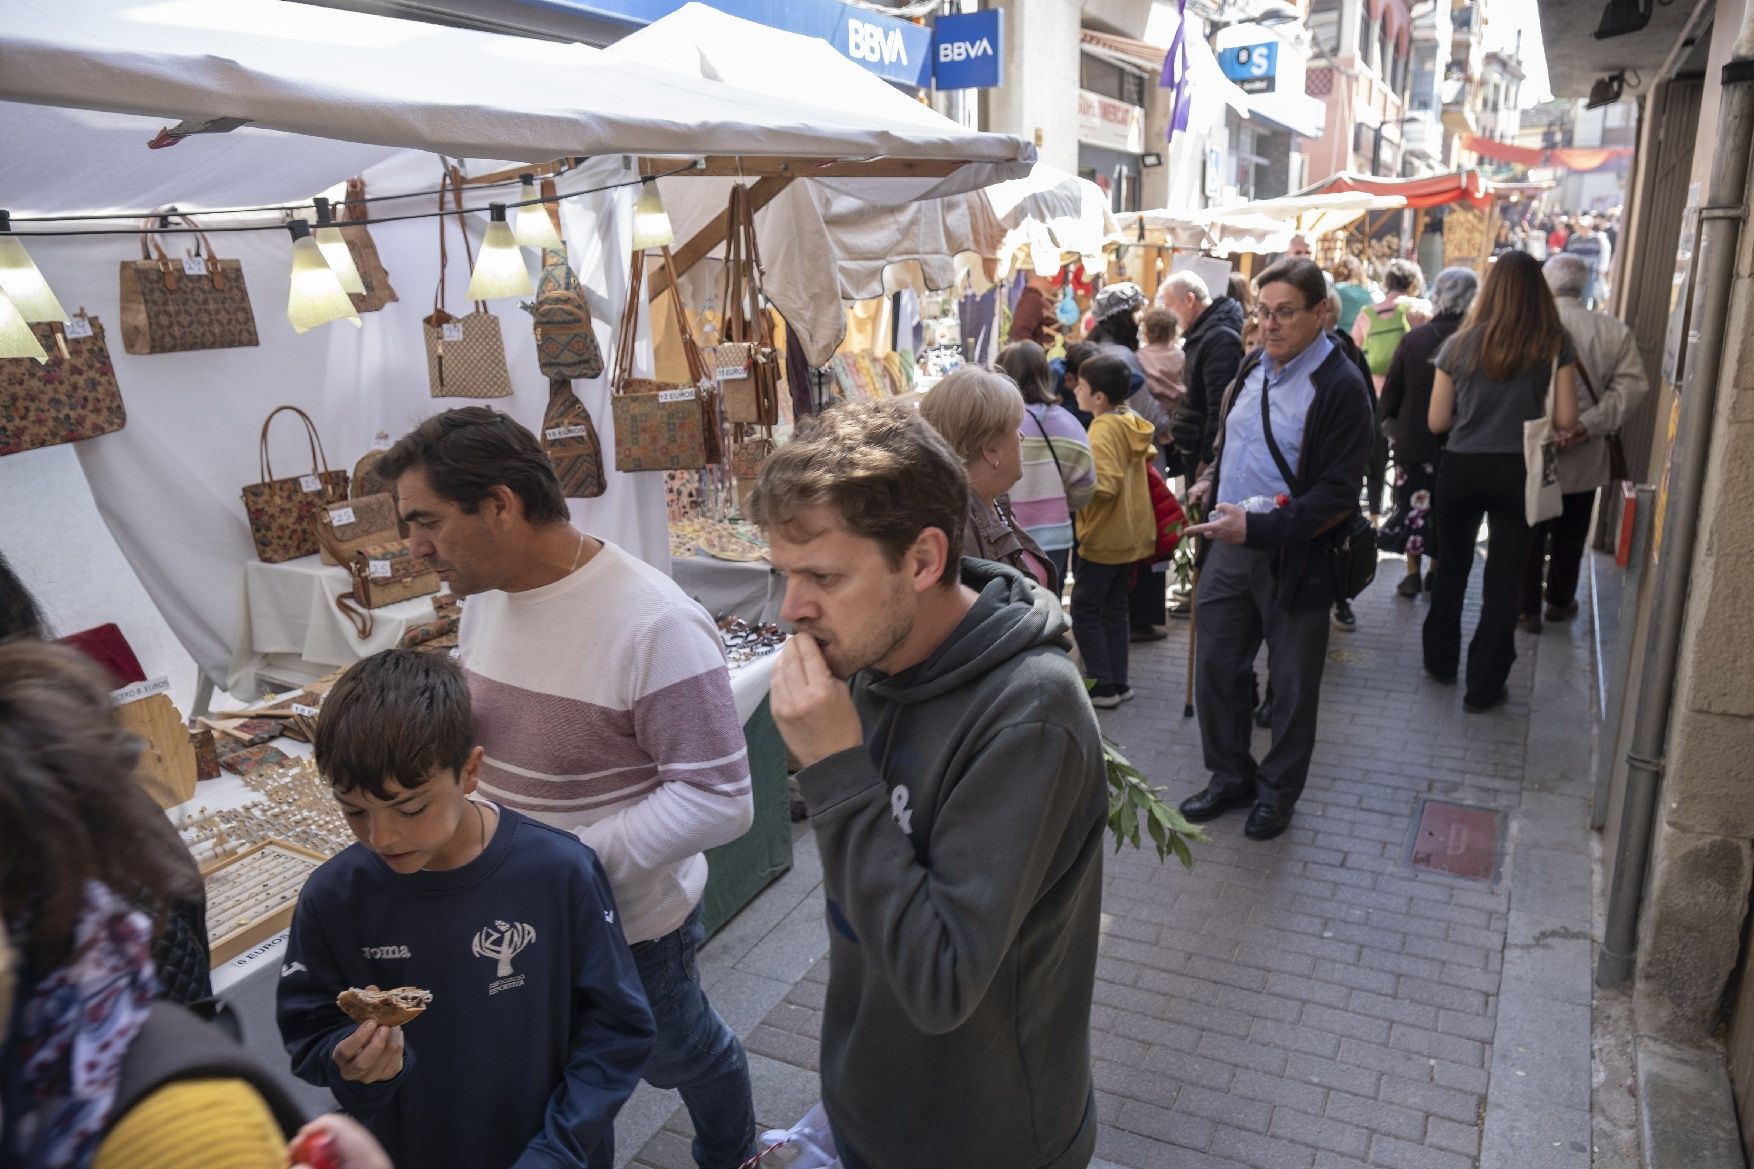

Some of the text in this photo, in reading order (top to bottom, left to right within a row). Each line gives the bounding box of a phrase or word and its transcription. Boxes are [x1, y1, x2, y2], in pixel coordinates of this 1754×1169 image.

[848, 18, 908, 66] BBVA
[939, 37, 993, 63] BBVA
[670, 390, 694, 400] EUROS
[143, 679, 170, 693] EUROS
[246, 933, 290, 960] EUROS
